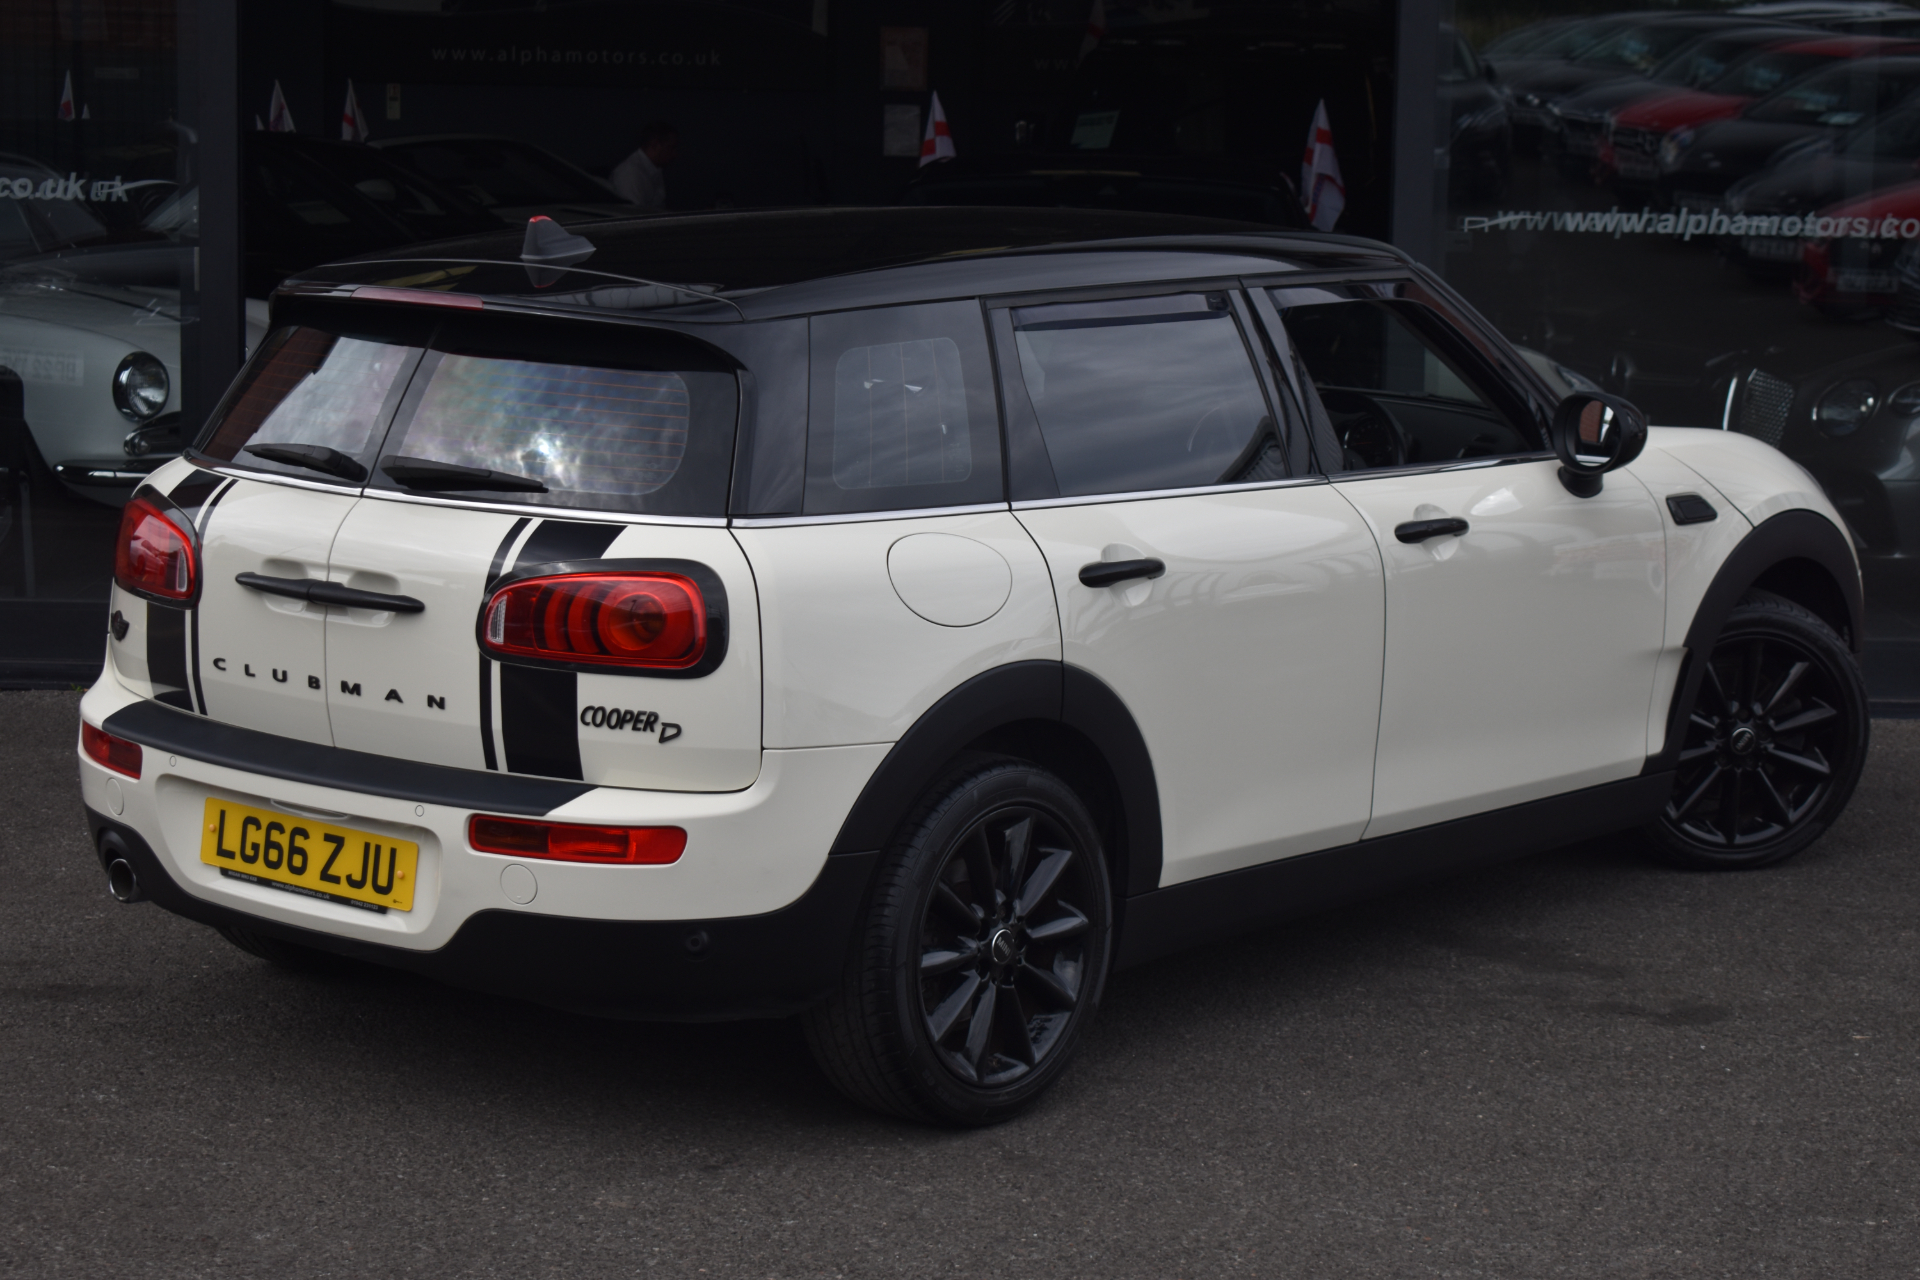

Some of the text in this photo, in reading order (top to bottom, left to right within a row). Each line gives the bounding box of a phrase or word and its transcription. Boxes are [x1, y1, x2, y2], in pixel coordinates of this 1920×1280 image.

[431, 45, 722, 66] www.alphamotors.co.uk
[212, 656, 447, 711] CLUBMAN
[580, 704, 683, 744] COOPER D
[216, 808, 398, 896] LG66 ZJU
[271, 881, 331, 900] www.alphamotors.co.uk
[996, 936, 1012, 957] MINI
